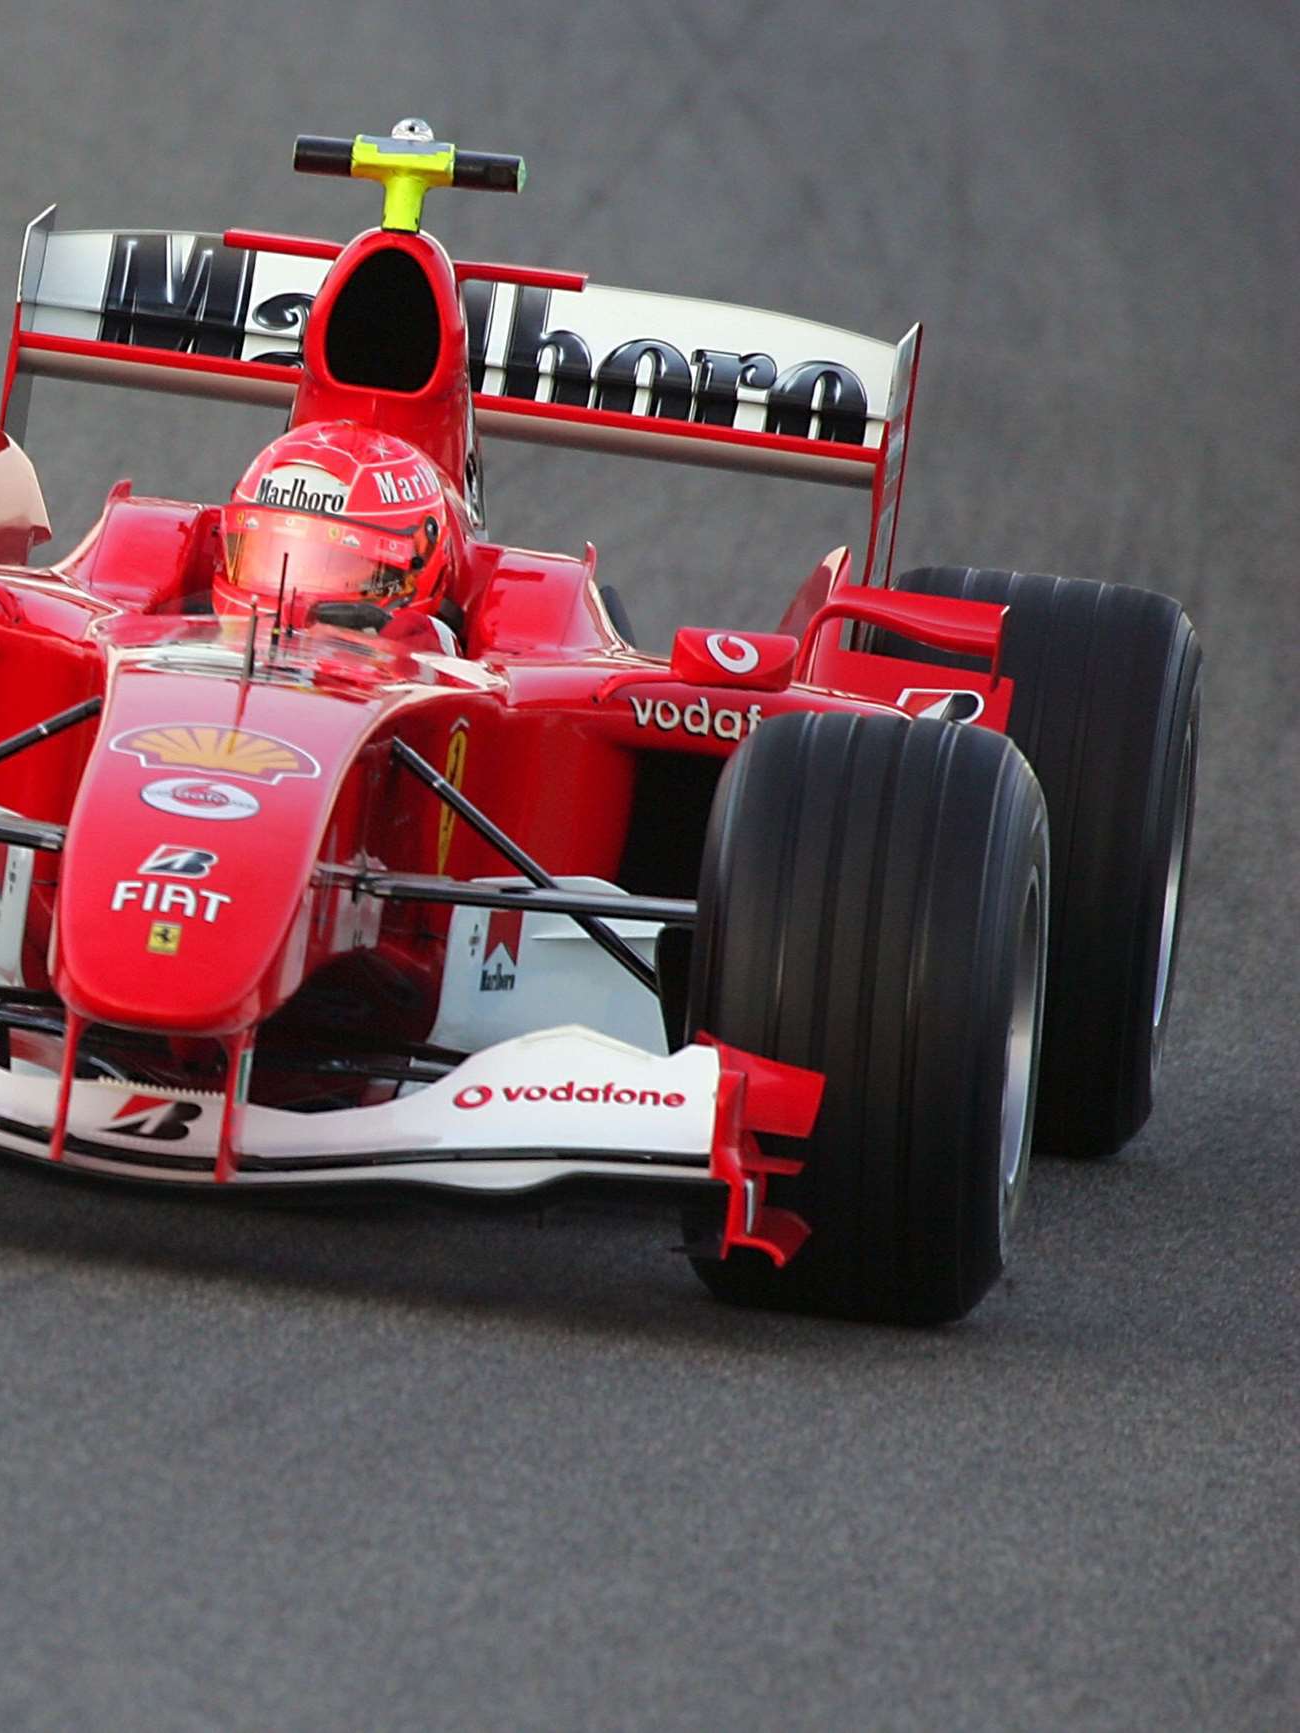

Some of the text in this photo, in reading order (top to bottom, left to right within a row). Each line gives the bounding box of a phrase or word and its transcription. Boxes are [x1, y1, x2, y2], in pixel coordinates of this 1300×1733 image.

[256, 477, 345, 512] Marlboro
[111, 880, 232, 923] FIAT
[503, 1081, 686, 1108] vodafone
